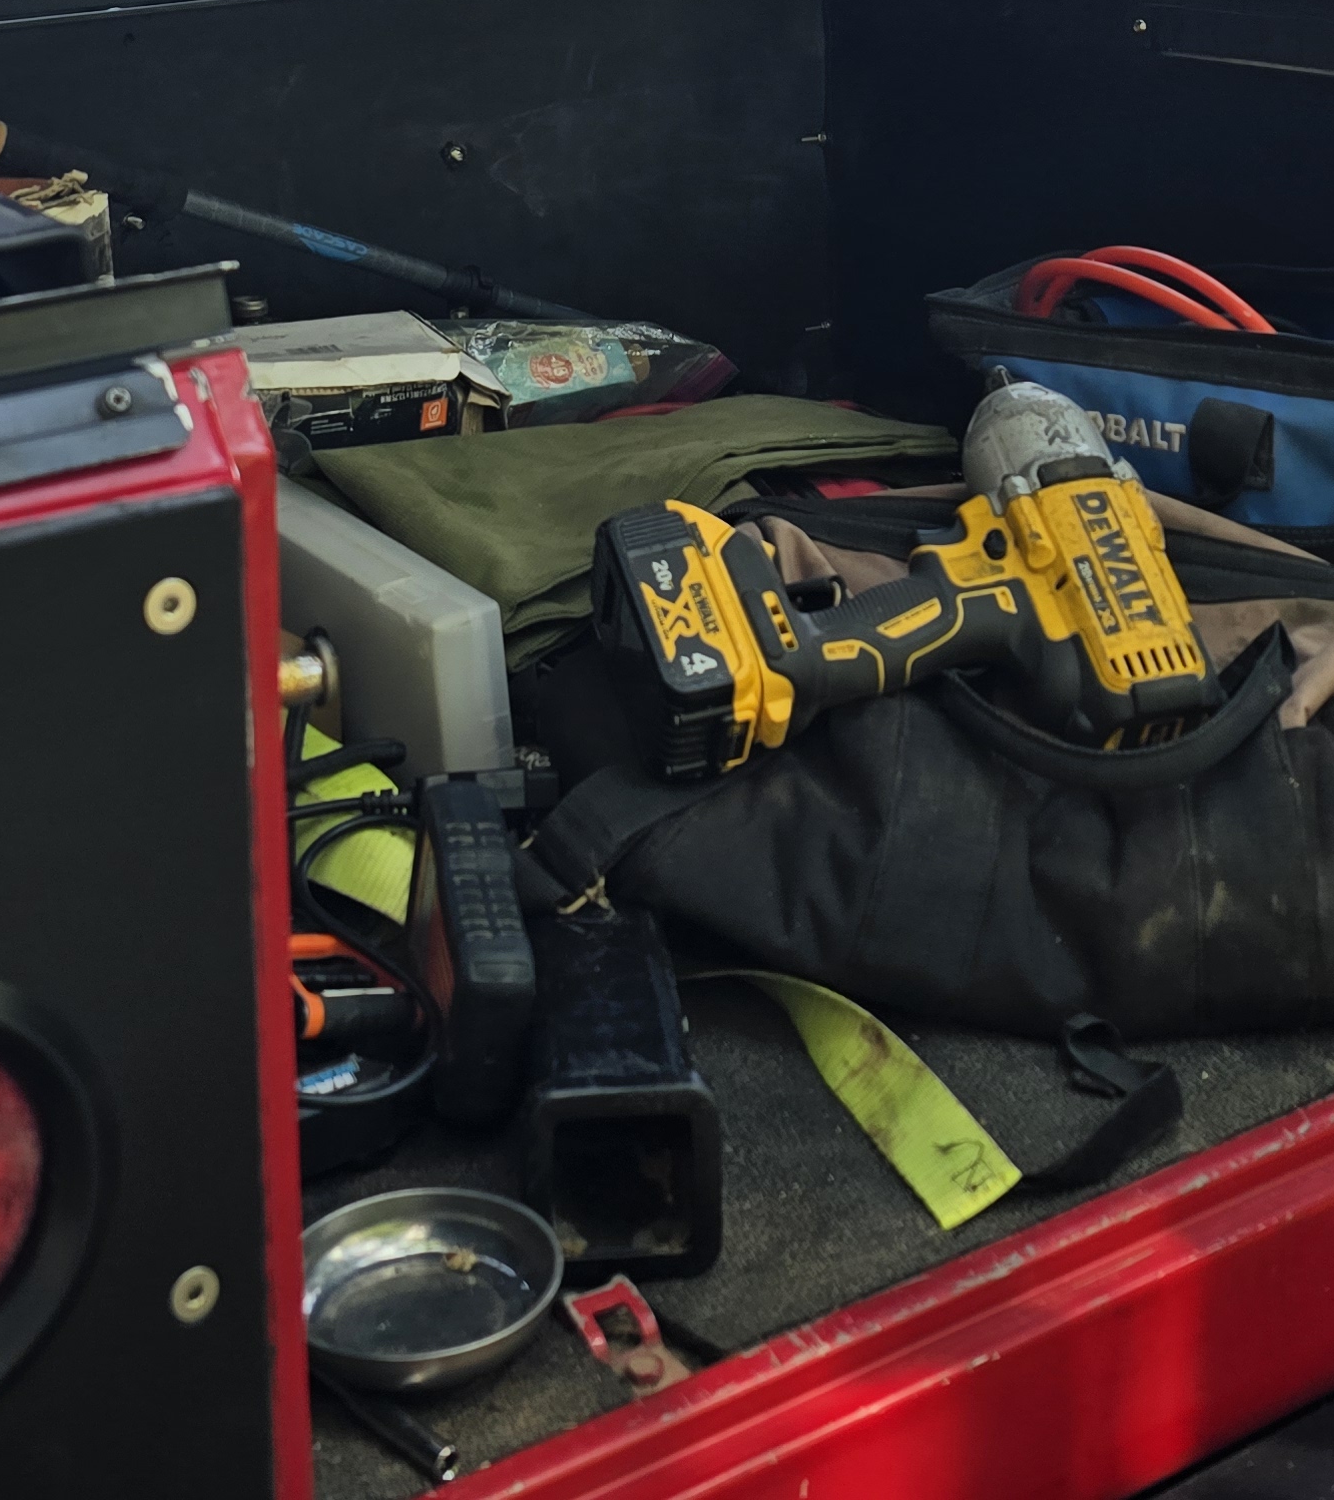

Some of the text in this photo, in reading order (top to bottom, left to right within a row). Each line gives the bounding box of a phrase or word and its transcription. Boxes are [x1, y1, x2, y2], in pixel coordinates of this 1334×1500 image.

[291, 222, 367, 256] CASCADE
[1075, 491, 1167, 627] DEWALT
[688, 582, 720, 635] DEWALT
[691, 651, 718, 675] 4
